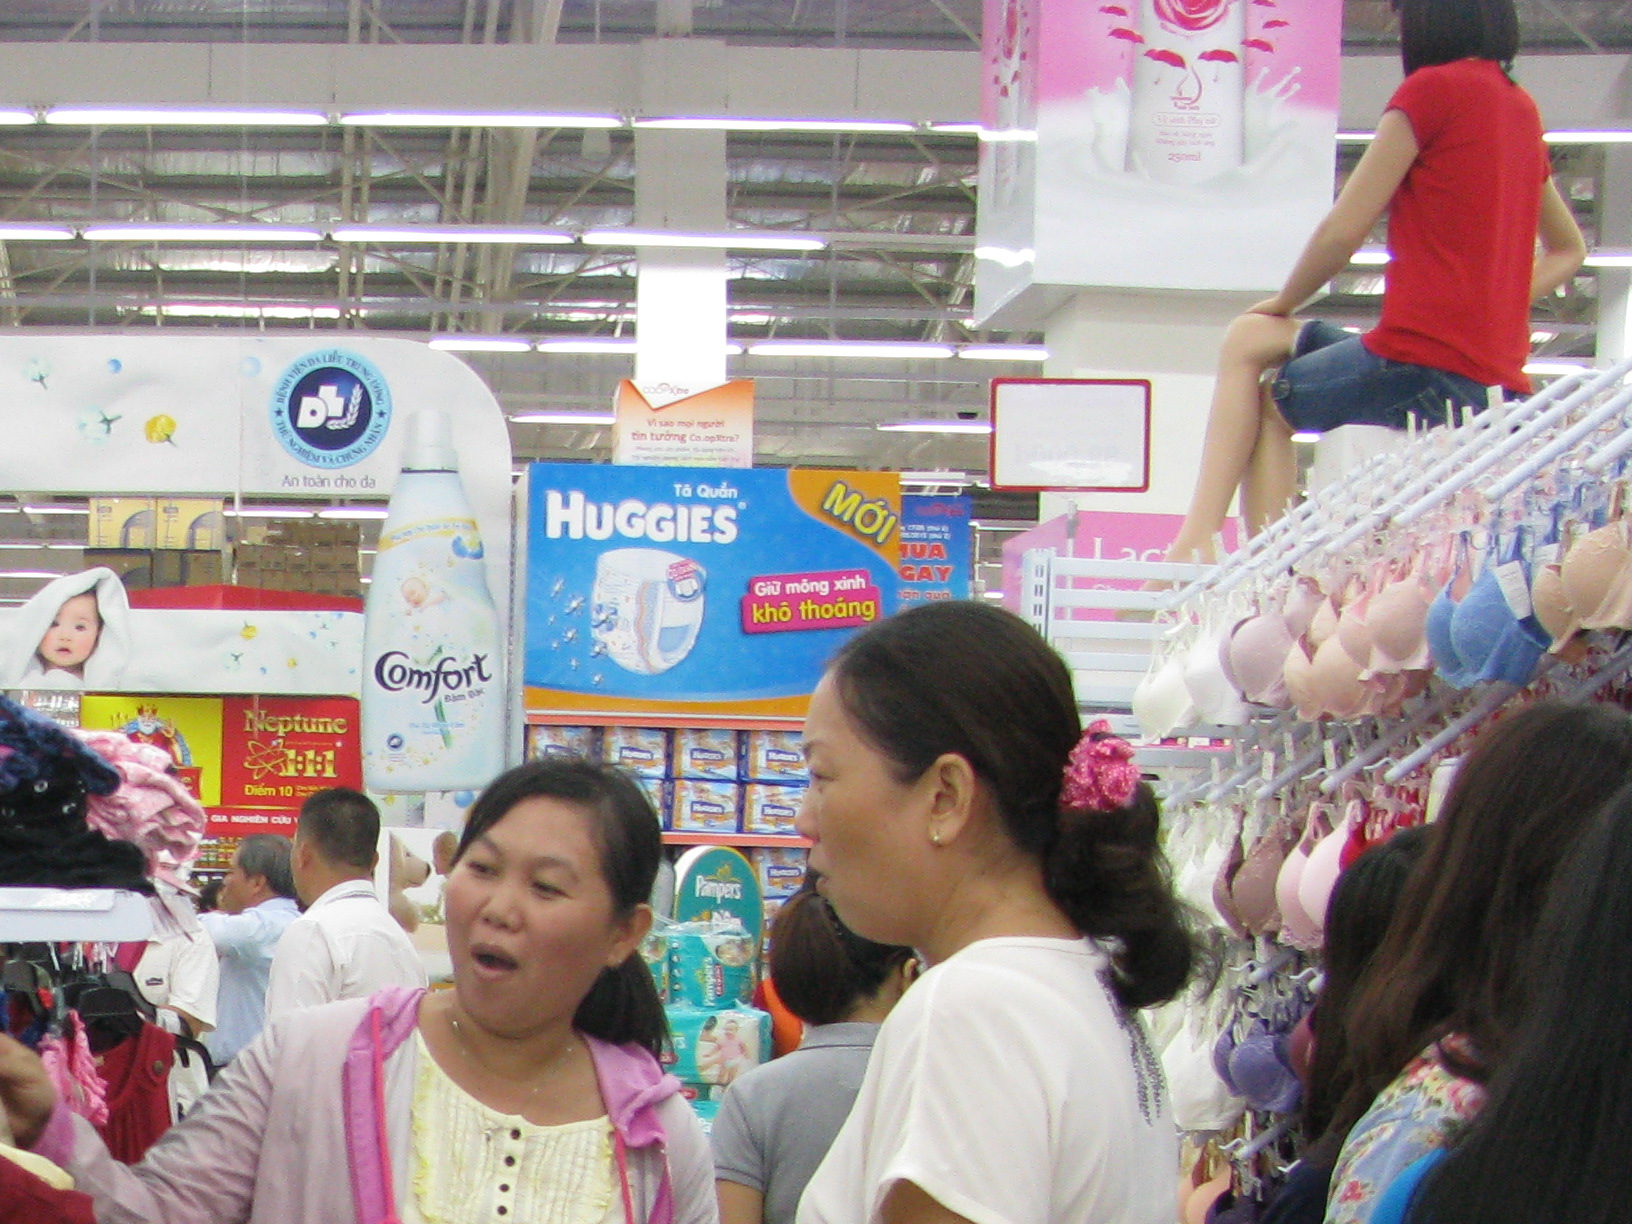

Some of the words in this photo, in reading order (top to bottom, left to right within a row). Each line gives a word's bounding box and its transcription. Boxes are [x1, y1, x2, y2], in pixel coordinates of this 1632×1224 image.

[659, 420, 675, 428] sao
[631, 431, 648, 441] tin
[282, 475, 300, 488] An
[303, 475, 331, 488] toàn
[334, 475, 357, 488] cho
[360, 475, 376, 489] da
[754, 579, 782, 597] Giữ
[785, 577, 830, 597] mông
[834, 575, 866, 591] xinh
[752, 601, 793, 624] khô
[799, 596, 877, 622] thoáng
[374, 650, 493, 704] Comfort
[243, 709, 348, 737] Neptune
[278, 785, 293, 797] 10
[695, 875, 742, 904] Pampers
